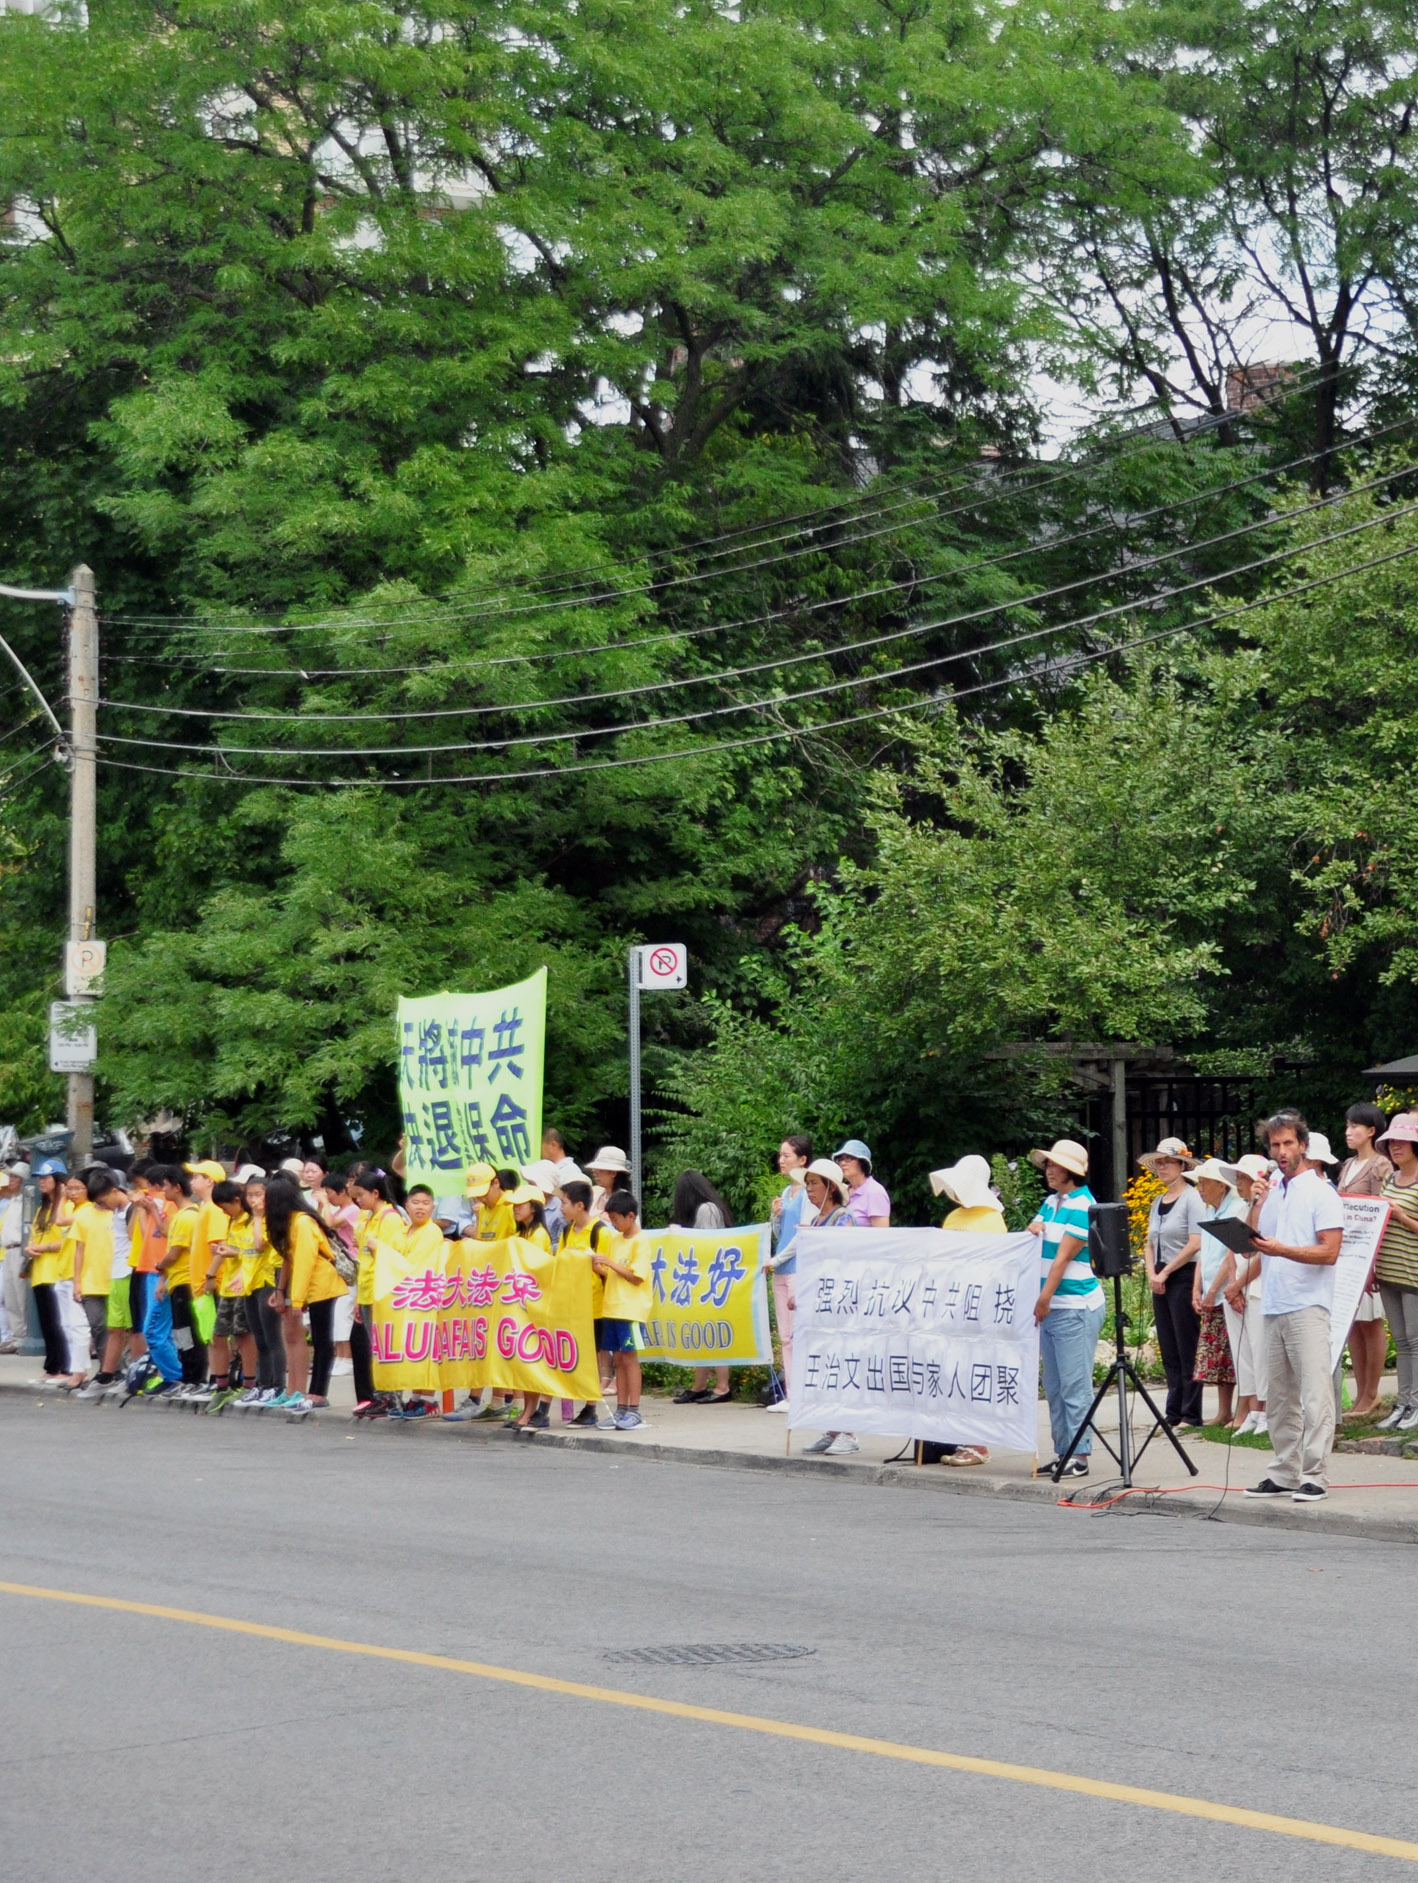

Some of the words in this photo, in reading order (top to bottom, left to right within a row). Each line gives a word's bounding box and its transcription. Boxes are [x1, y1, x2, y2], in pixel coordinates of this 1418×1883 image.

[392, 1262, 542, 1313] 法大法好
[496, 1315, 578, 1372] GOOD
[681, 1321, 733, 1350] GOOD
